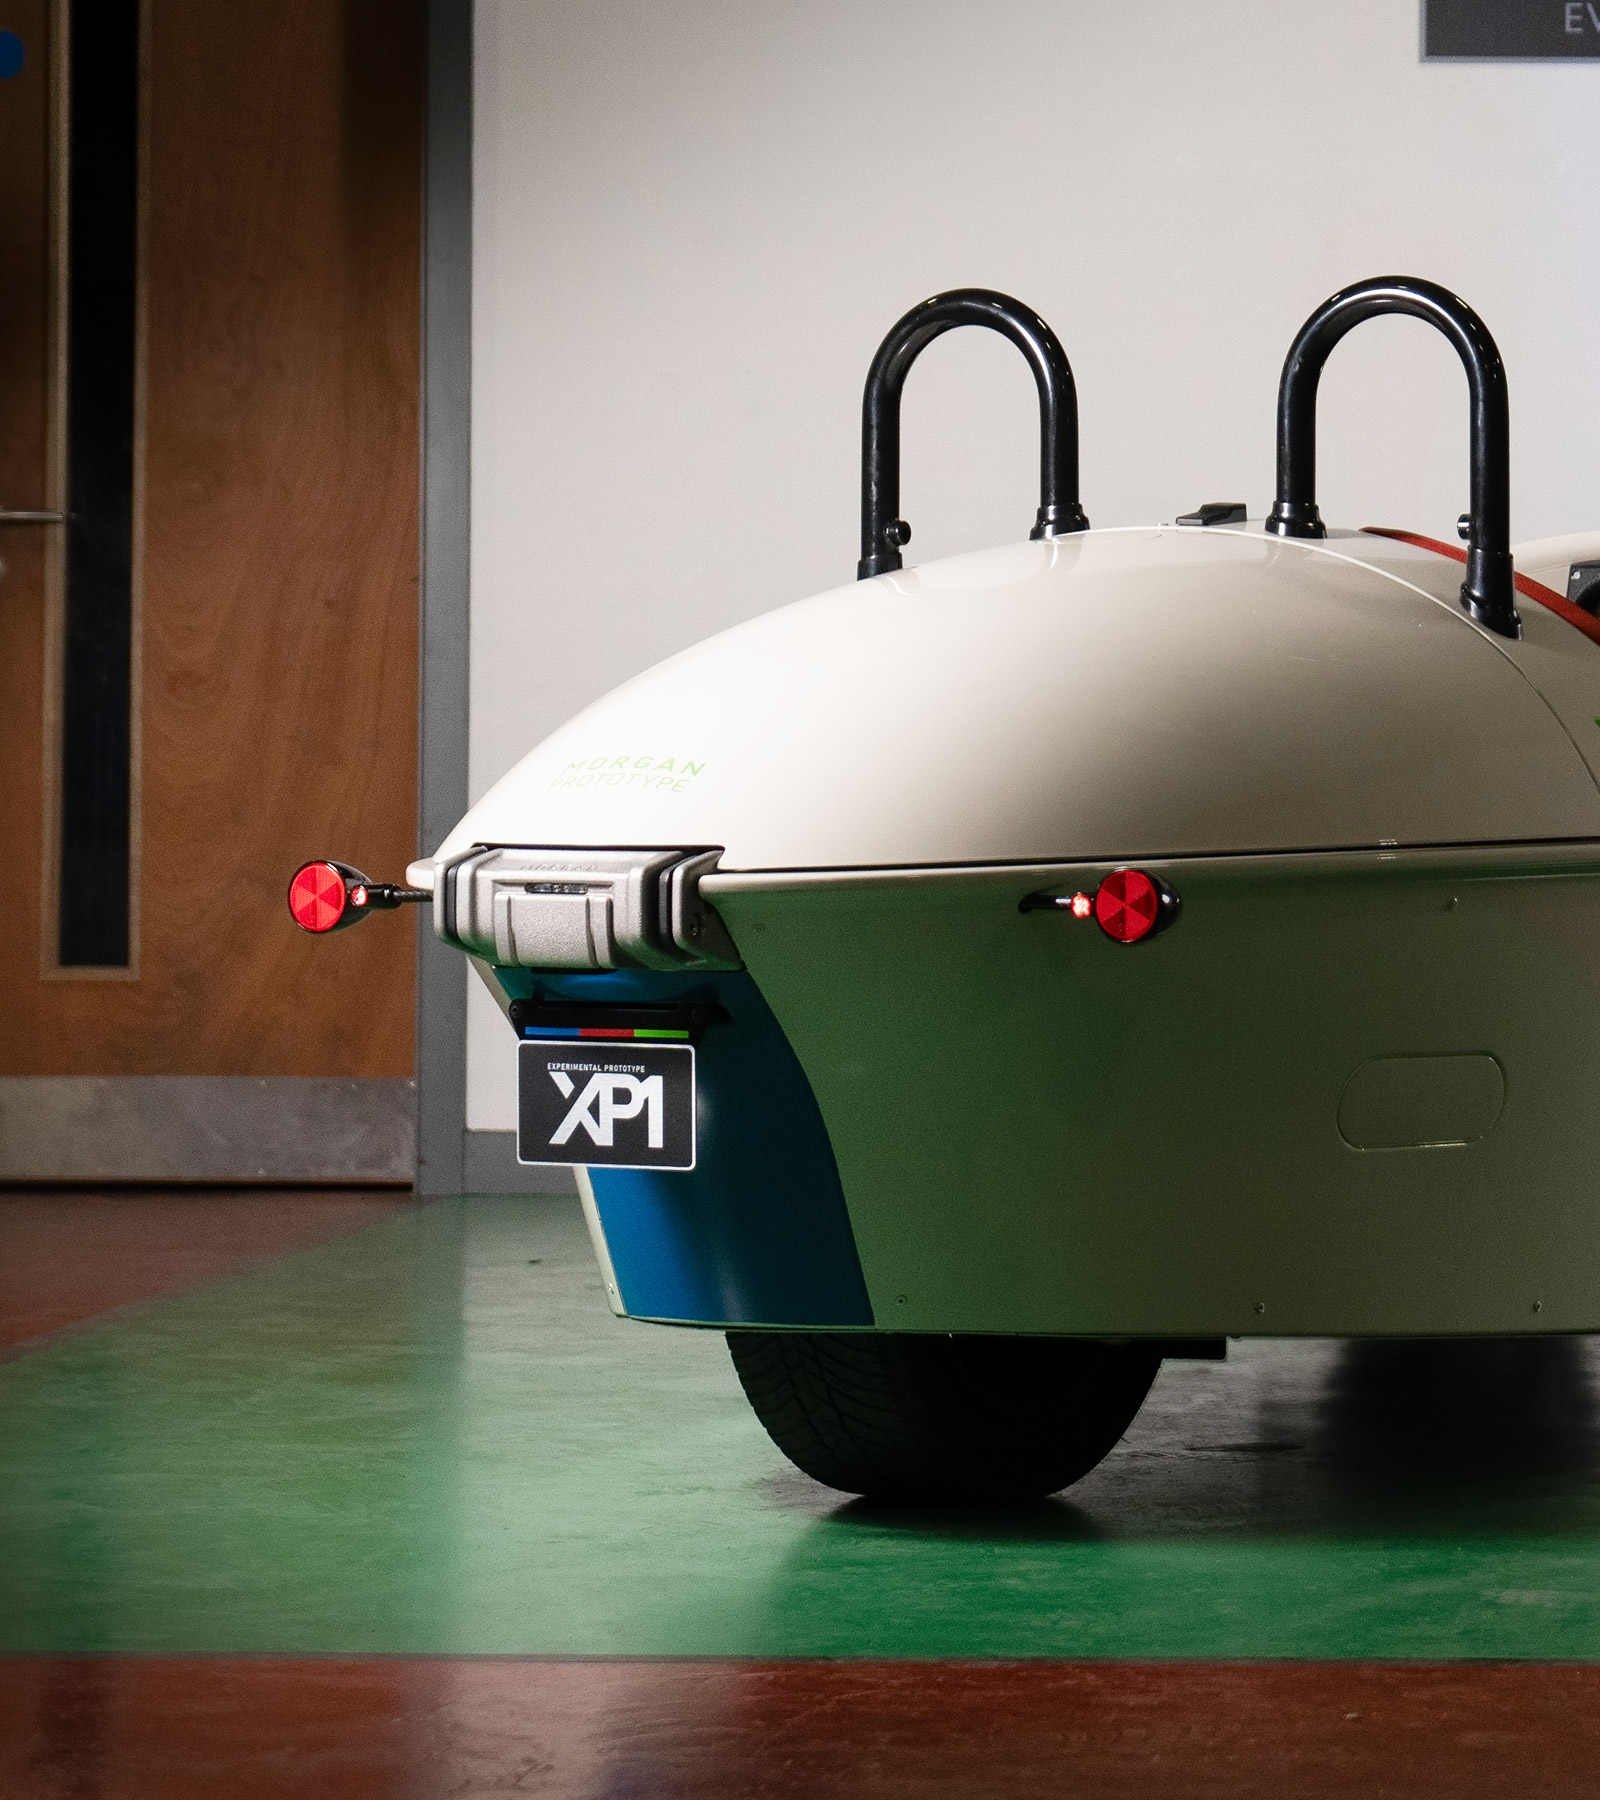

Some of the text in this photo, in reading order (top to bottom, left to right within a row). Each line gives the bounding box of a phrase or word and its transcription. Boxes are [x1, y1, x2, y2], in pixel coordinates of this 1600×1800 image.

[561, 755, 706, 776] MORGAN
[547, 773, 691, 793] PROTOTYPE
[547, 1062, 645, 1073] EXPERIMENTAL PROTOTYPE
[549, 1071, 663, 1148] XP1
